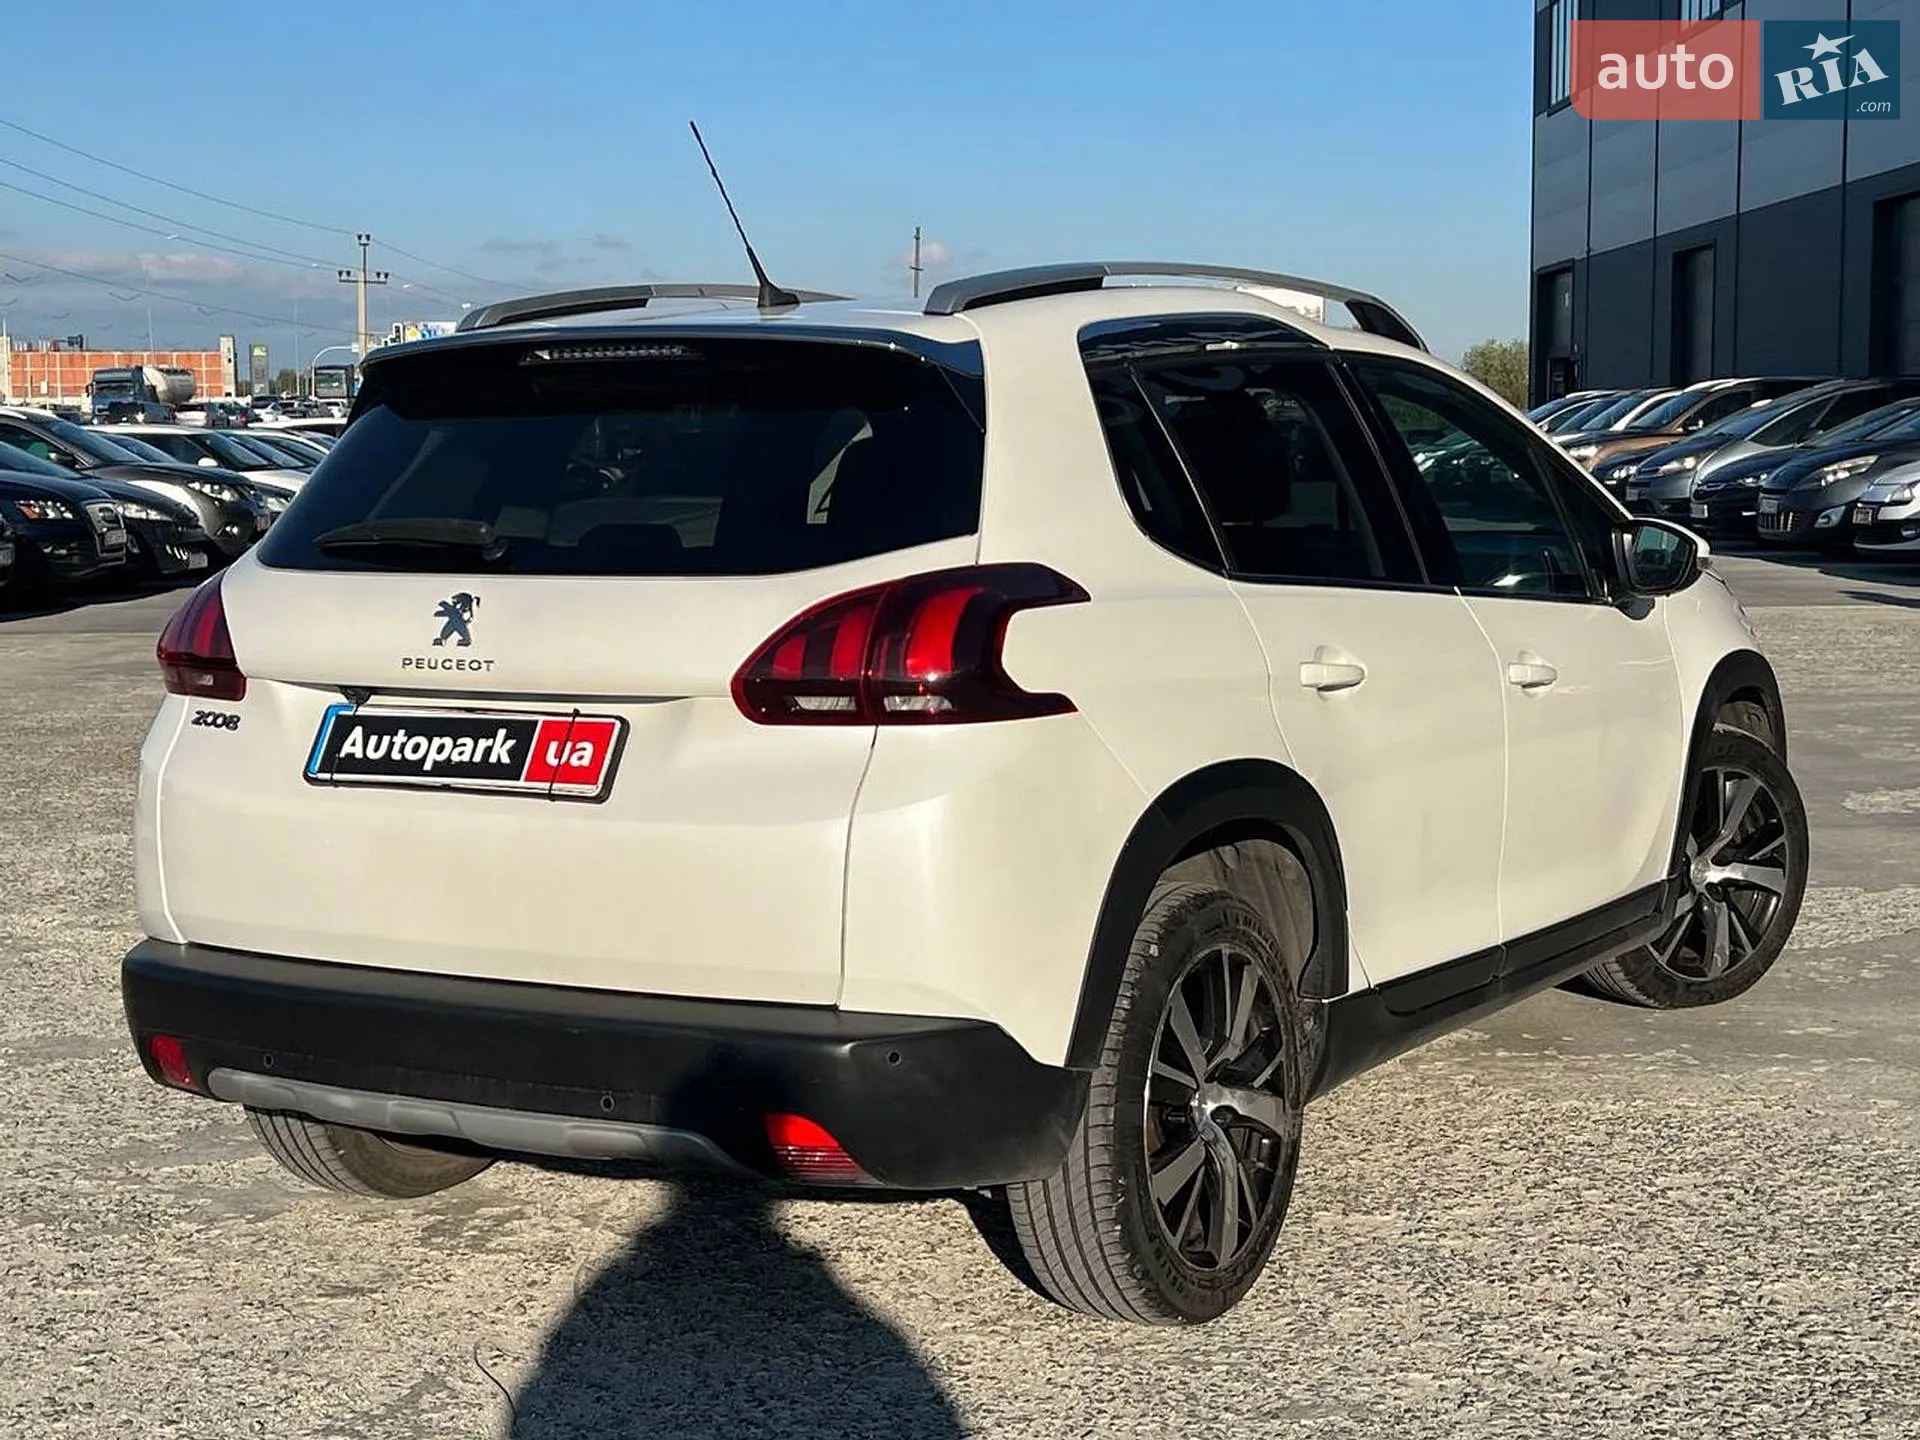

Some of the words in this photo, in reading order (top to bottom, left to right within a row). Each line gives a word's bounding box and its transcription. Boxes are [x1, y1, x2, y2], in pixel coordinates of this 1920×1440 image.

[401, 657, 495, 672] PEUGEOT
[191, 710, 241, 731] 2008
[338, 725, 517, 771] Autopark
[545, 740, 594, 767] ua
